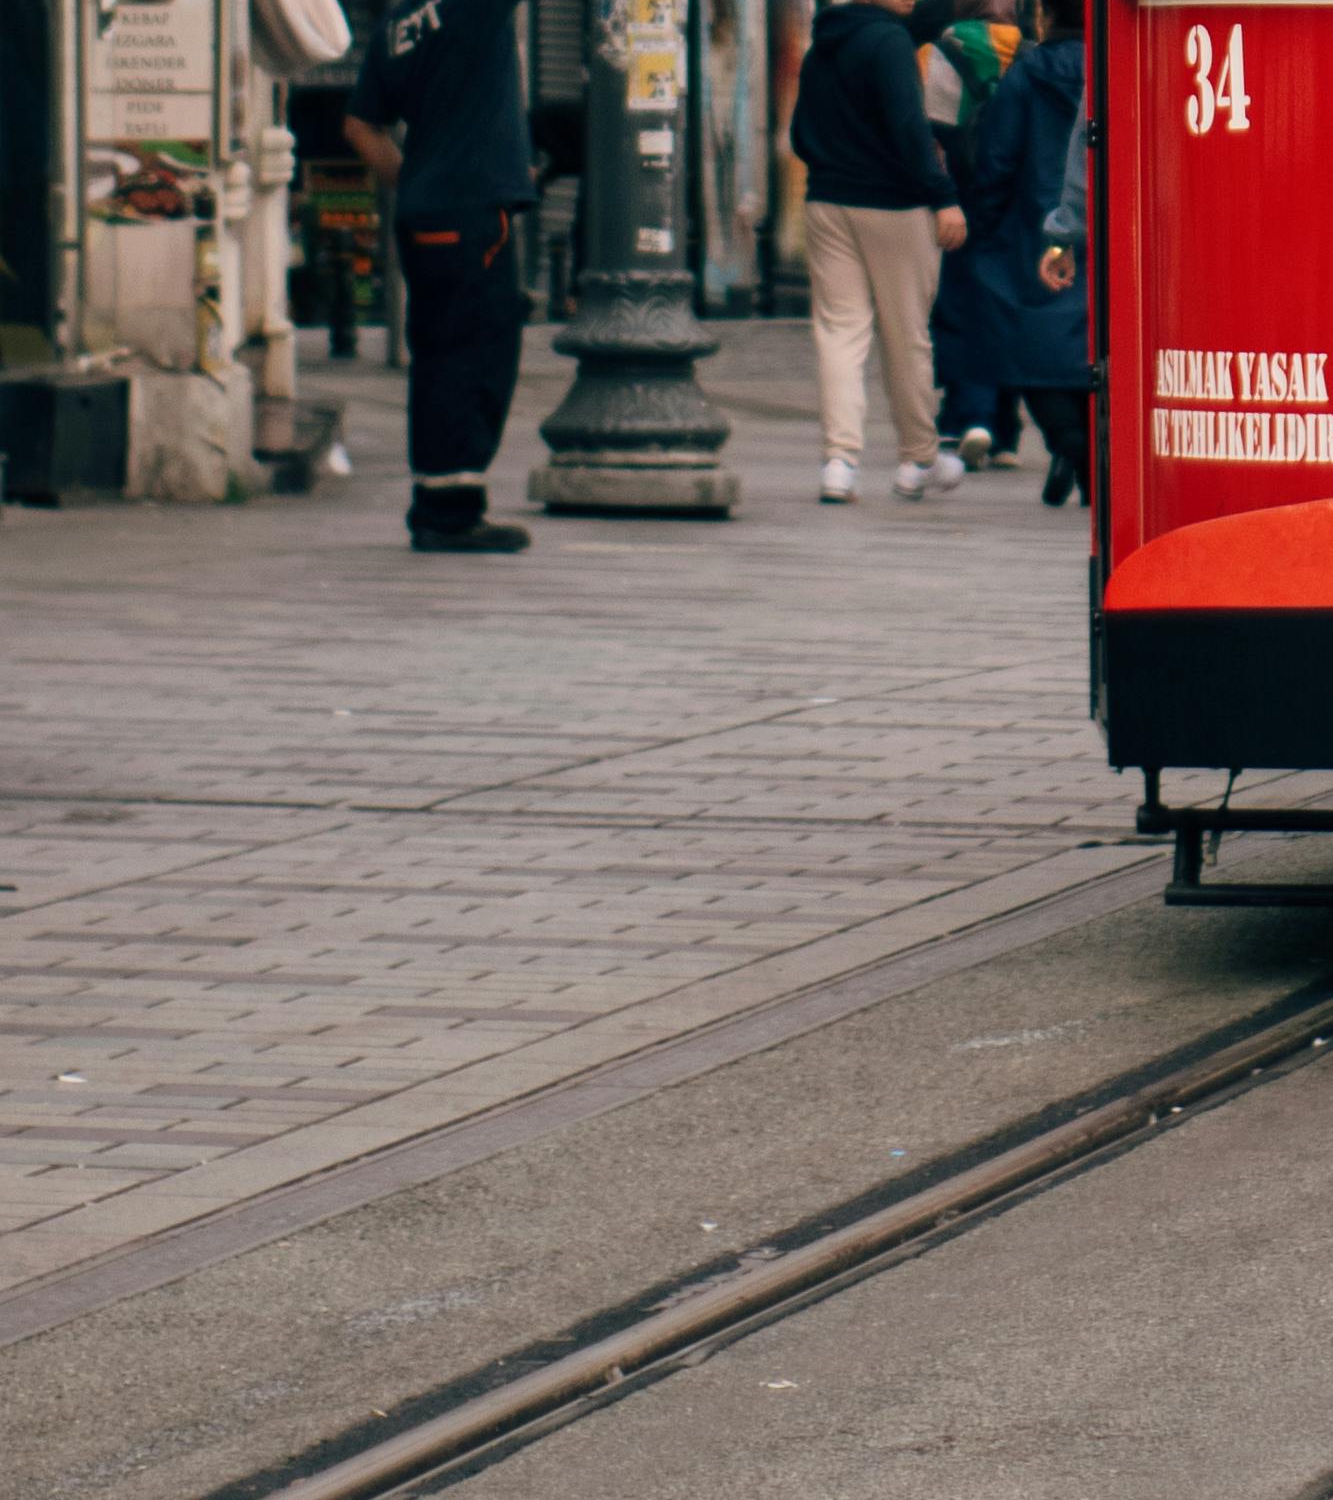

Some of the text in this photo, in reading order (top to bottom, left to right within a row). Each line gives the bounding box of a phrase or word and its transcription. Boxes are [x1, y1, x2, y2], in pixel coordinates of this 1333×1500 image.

[1187, 23, 1251, 135] 34
[1157, 349, 1329, 402] ASILMAK YASAK
[1153, 408, 1170, 456] VE
